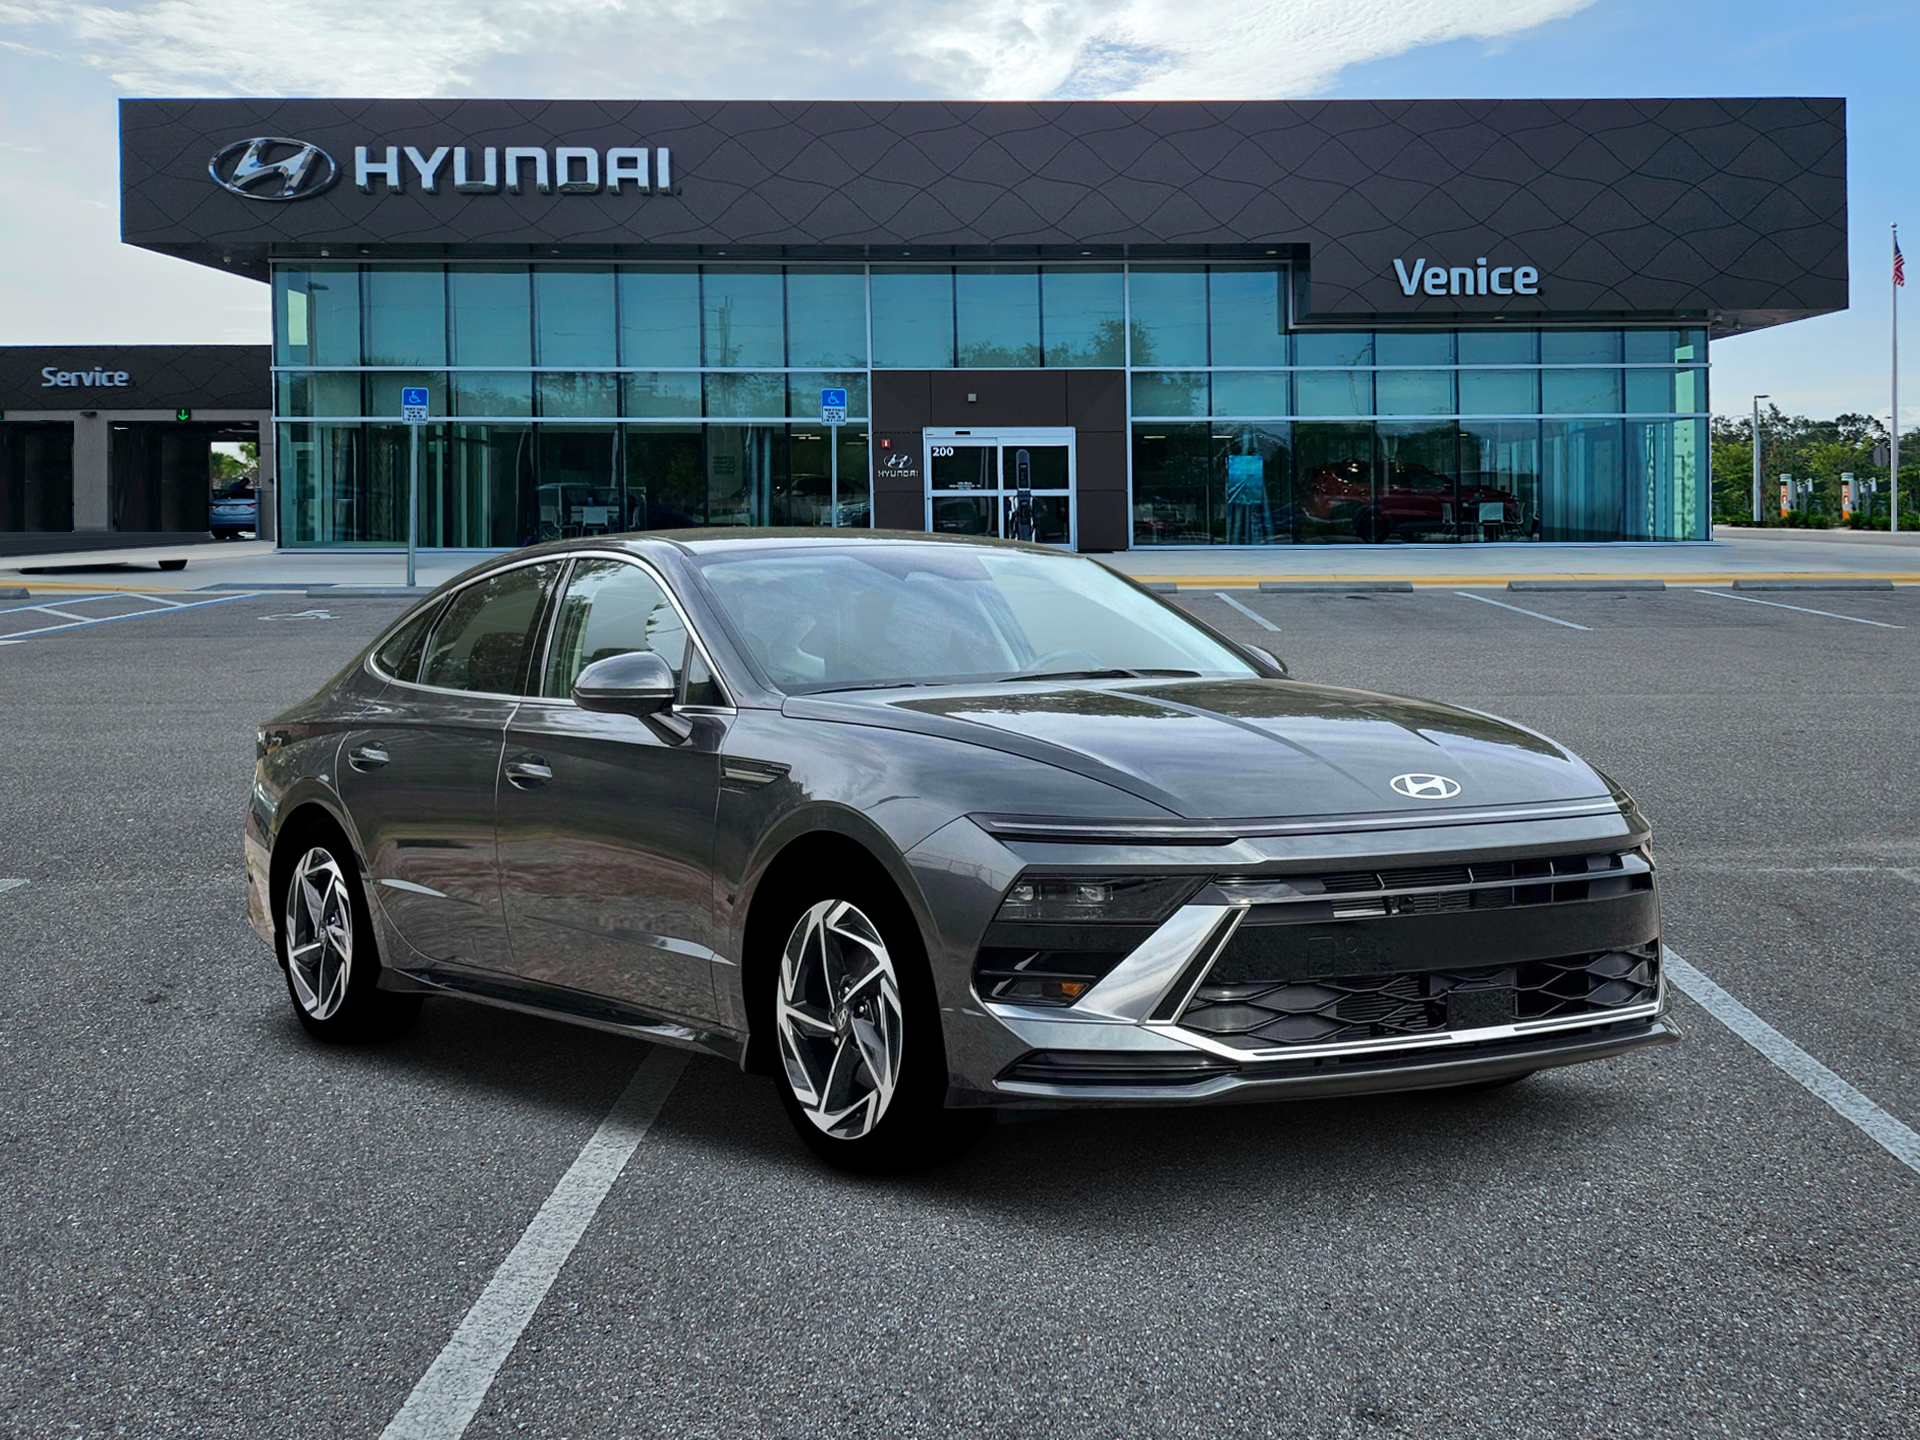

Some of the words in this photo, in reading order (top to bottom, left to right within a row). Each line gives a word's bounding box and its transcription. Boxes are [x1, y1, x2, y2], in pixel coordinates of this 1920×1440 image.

[354, 146, 672, 195] HYUNDAI
[1392, 257, 1539, 296] Venice
[41, 366, 130, 388] Service
[932, 446, 955, 457] 200
[877, 469, 919, 478] HYUNDAI
